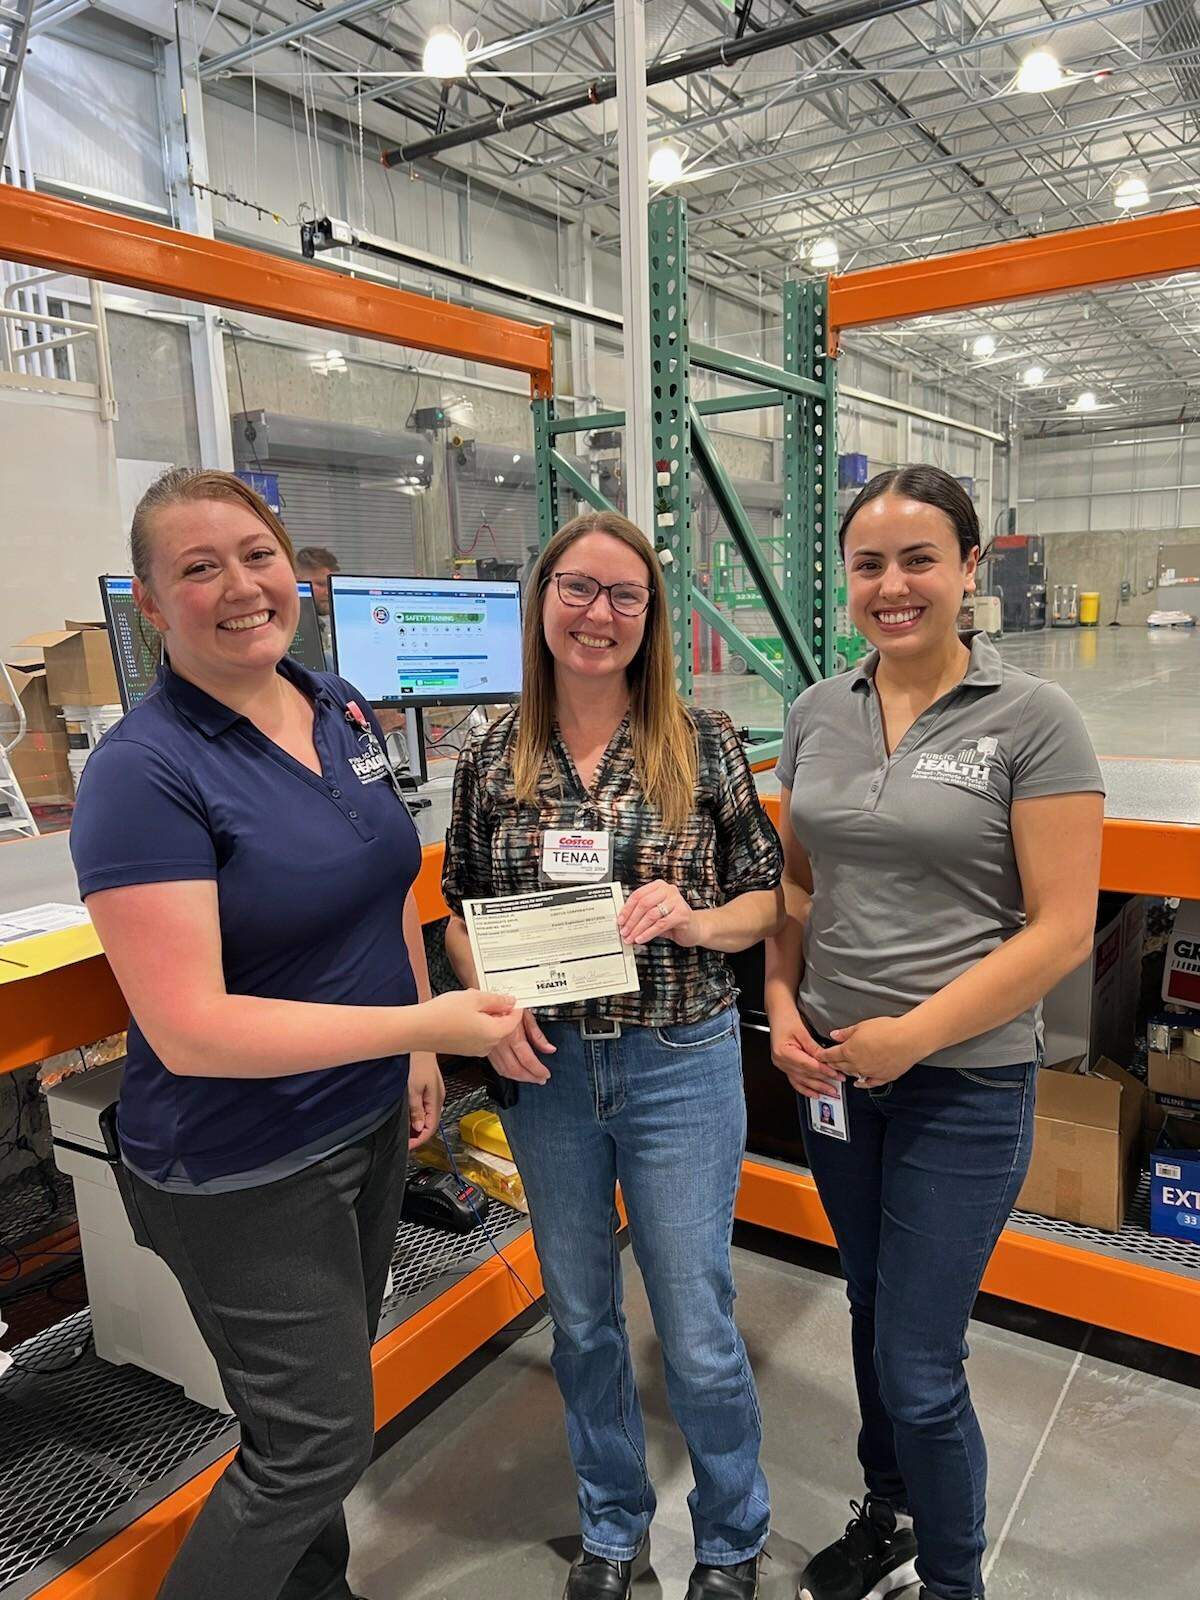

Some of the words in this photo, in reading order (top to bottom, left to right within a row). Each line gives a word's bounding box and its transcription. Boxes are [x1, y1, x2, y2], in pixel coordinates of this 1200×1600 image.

[920, 753, 954, 761] PUBLIC
[913, 758, 991, 780] HEALTH
[553, 851, 600, 864] TENAA
[536, 980, 567, 990] HEALTH
[1160, 1096, 1185, 1107] ULINE
[1184, 1214, 1198, 1226] 33
